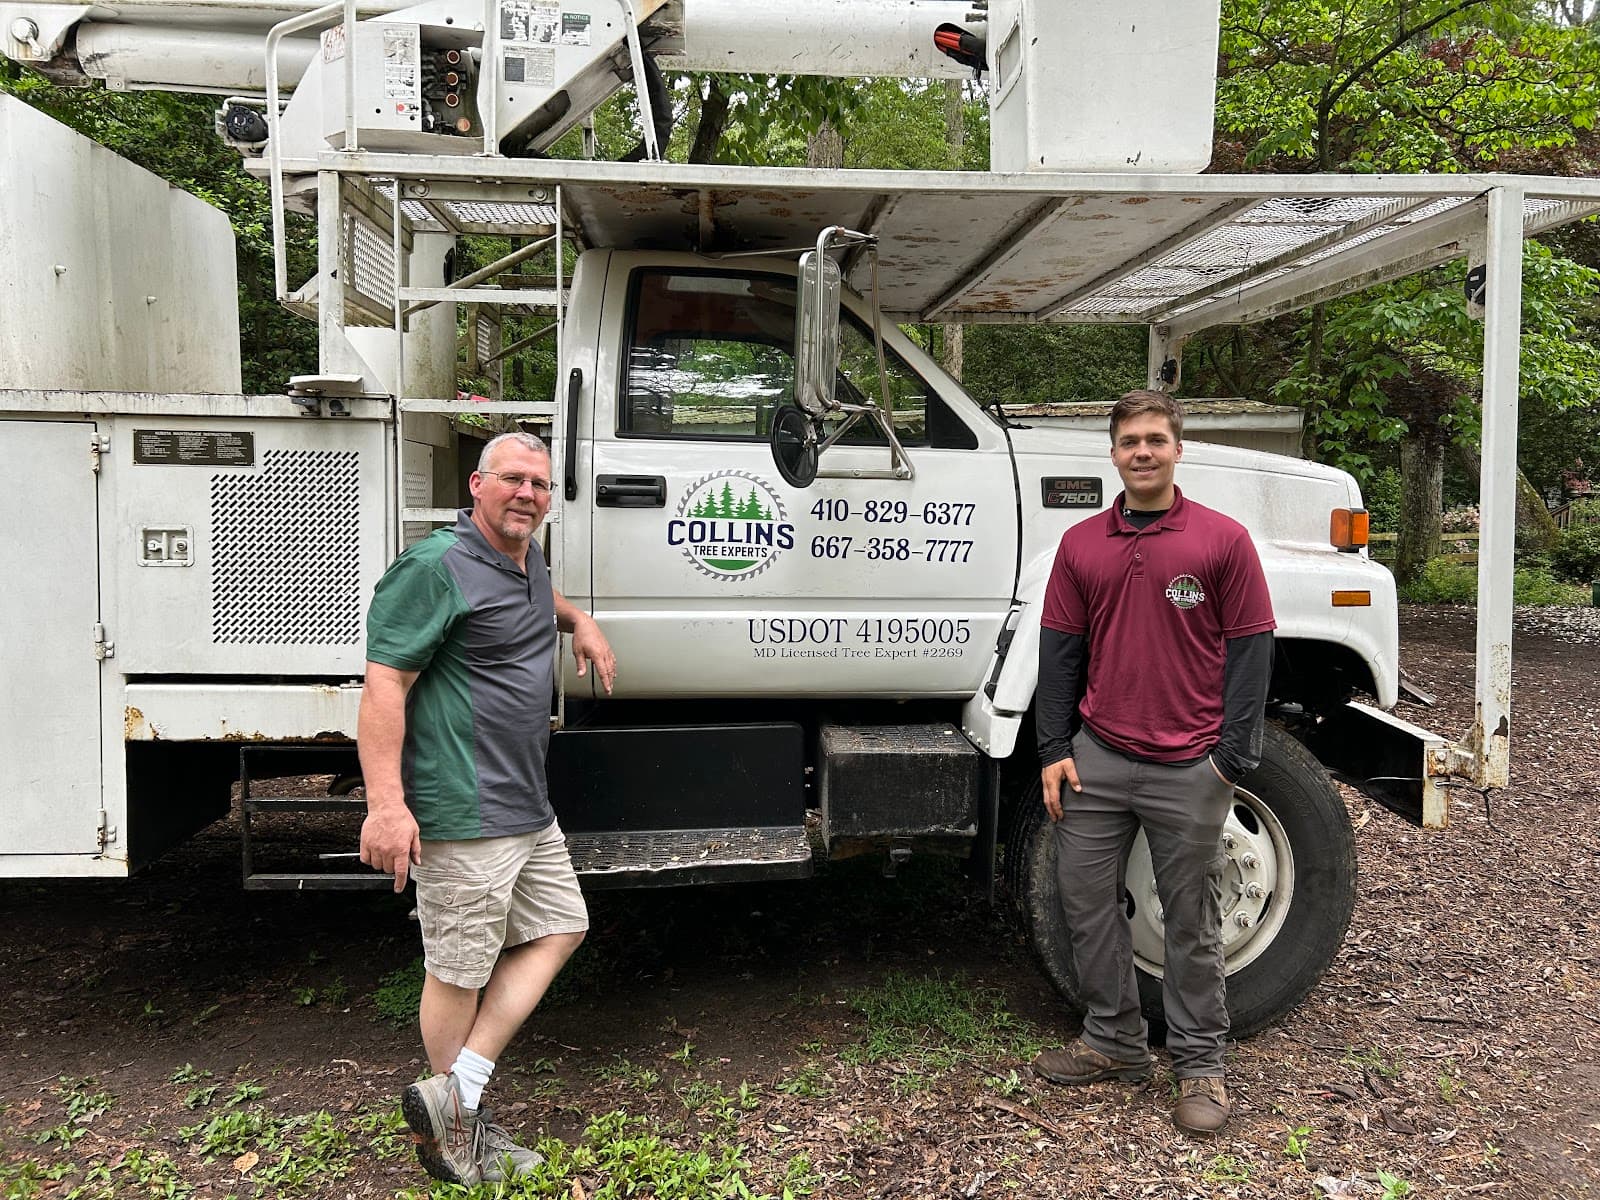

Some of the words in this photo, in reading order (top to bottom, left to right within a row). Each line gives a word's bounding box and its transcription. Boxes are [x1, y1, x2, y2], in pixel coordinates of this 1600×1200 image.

[1054, 480, 1092, 490] GMC
[1047, 492, 1099, 504] C7500
[810, 498, 976, 526] 410-829-6377
[667, 519, 795, 550] COLLINS
[692, 545, 719, 556] TREE
[721, 546, 768, 558] EXPERTS
[811, 535, 974, 562] 667-358-7777
[1165, 588, 1206, 602] COLLINS
[747, 618, 848, 643] USDOT
[856, 618, 971, 643] 4195005
[754, 647, 776, 658] MD
[780, 647, 838, 658] Licensed
[841, 647, 871, 658] Tree
[874, 647, 917, 660] Expert
[922, 647, 963, 658] #2269
